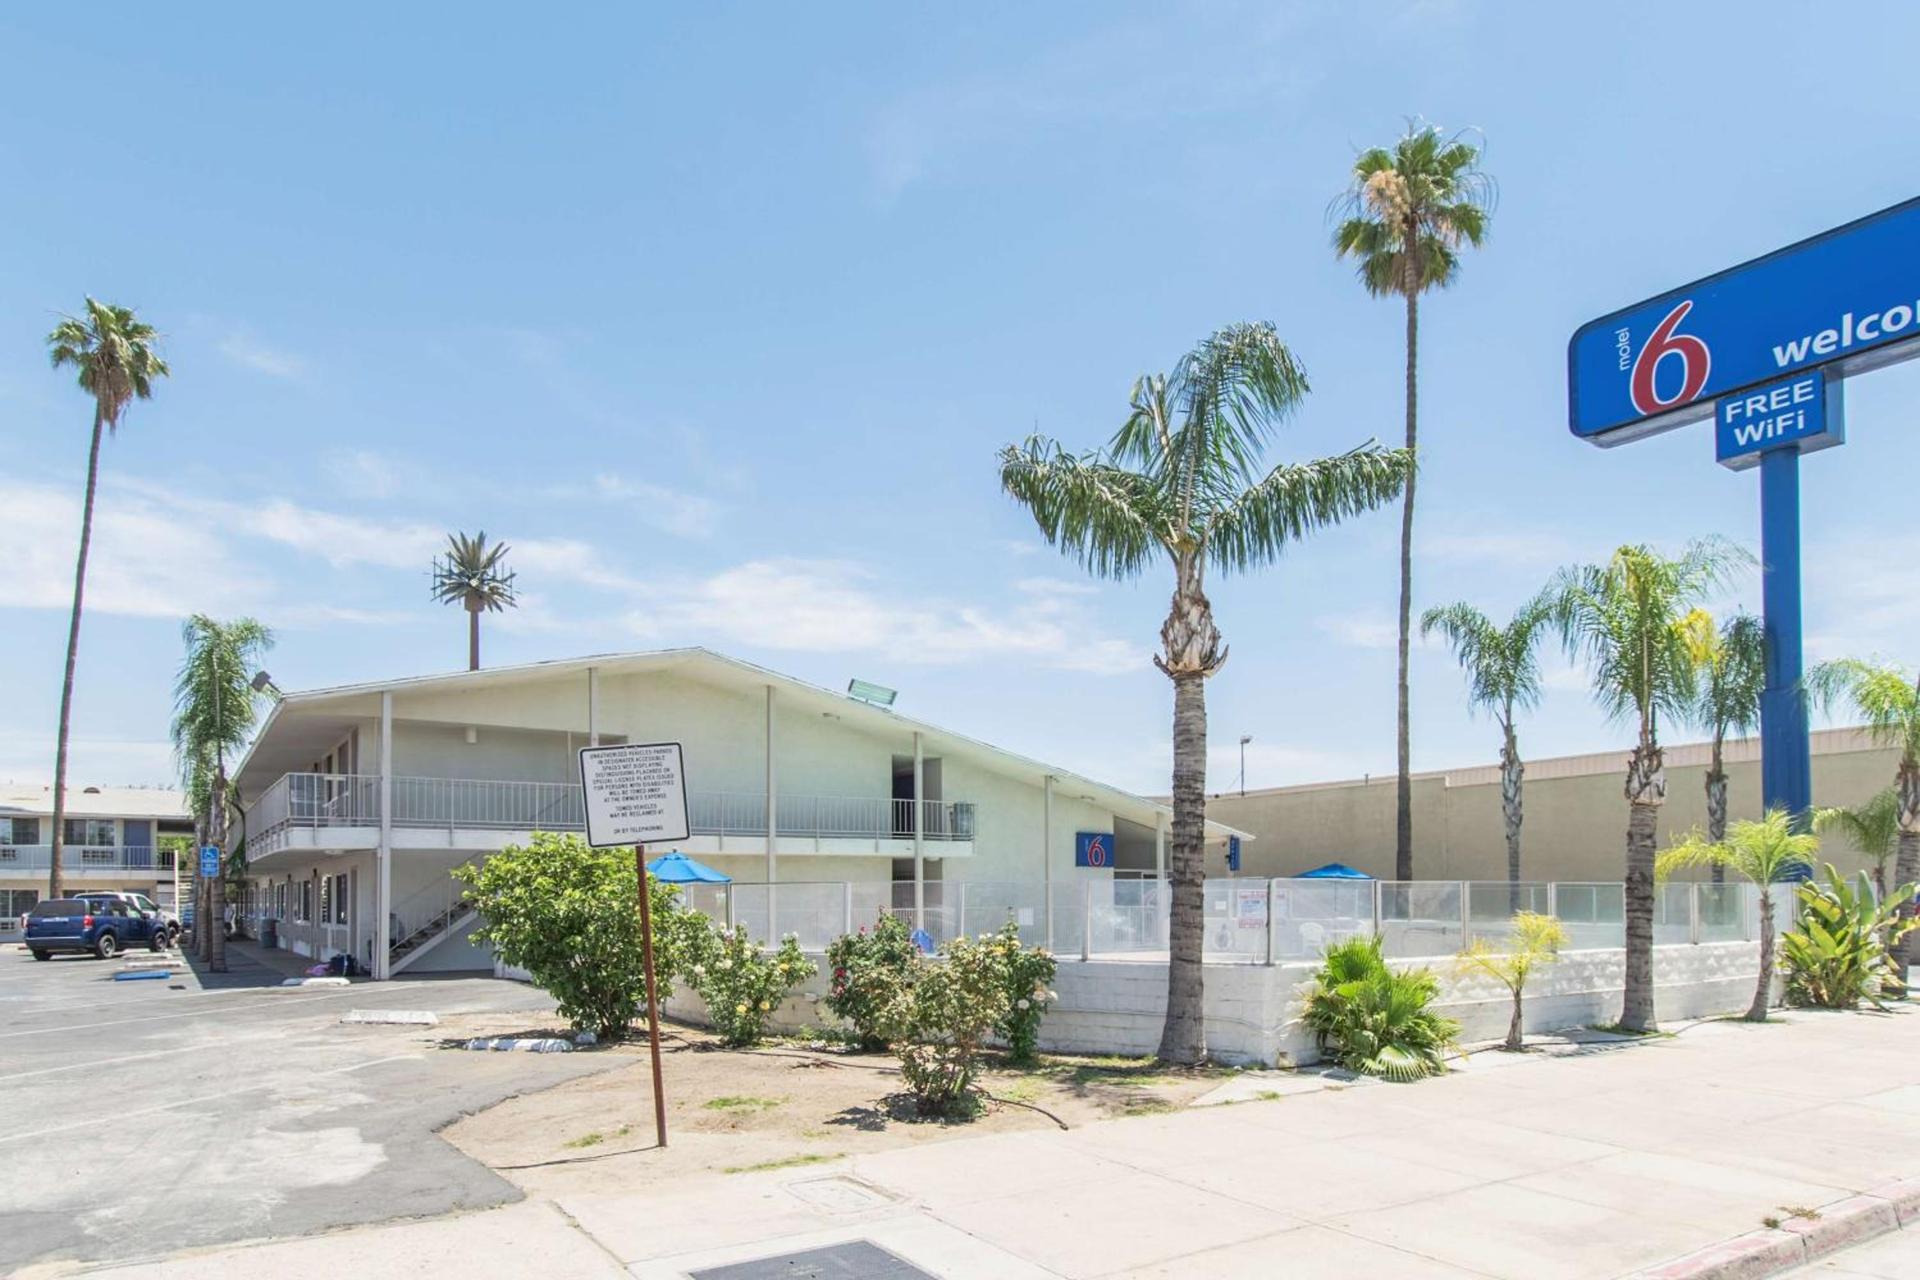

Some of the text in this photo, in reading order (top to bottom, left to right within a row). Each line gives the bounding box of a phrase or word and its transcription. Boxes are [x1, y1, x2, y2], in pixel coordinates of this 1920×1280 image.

[1614, 326, 1630, 371] motel
[1772, 299, 1920, 368] welco
[1629, 299, 1711, 415] 6
[1725, 379, 1815, 423] FREE
[1733, 410, 1805, 446] WiFi
[1088, 834, 1105, 867] 6
